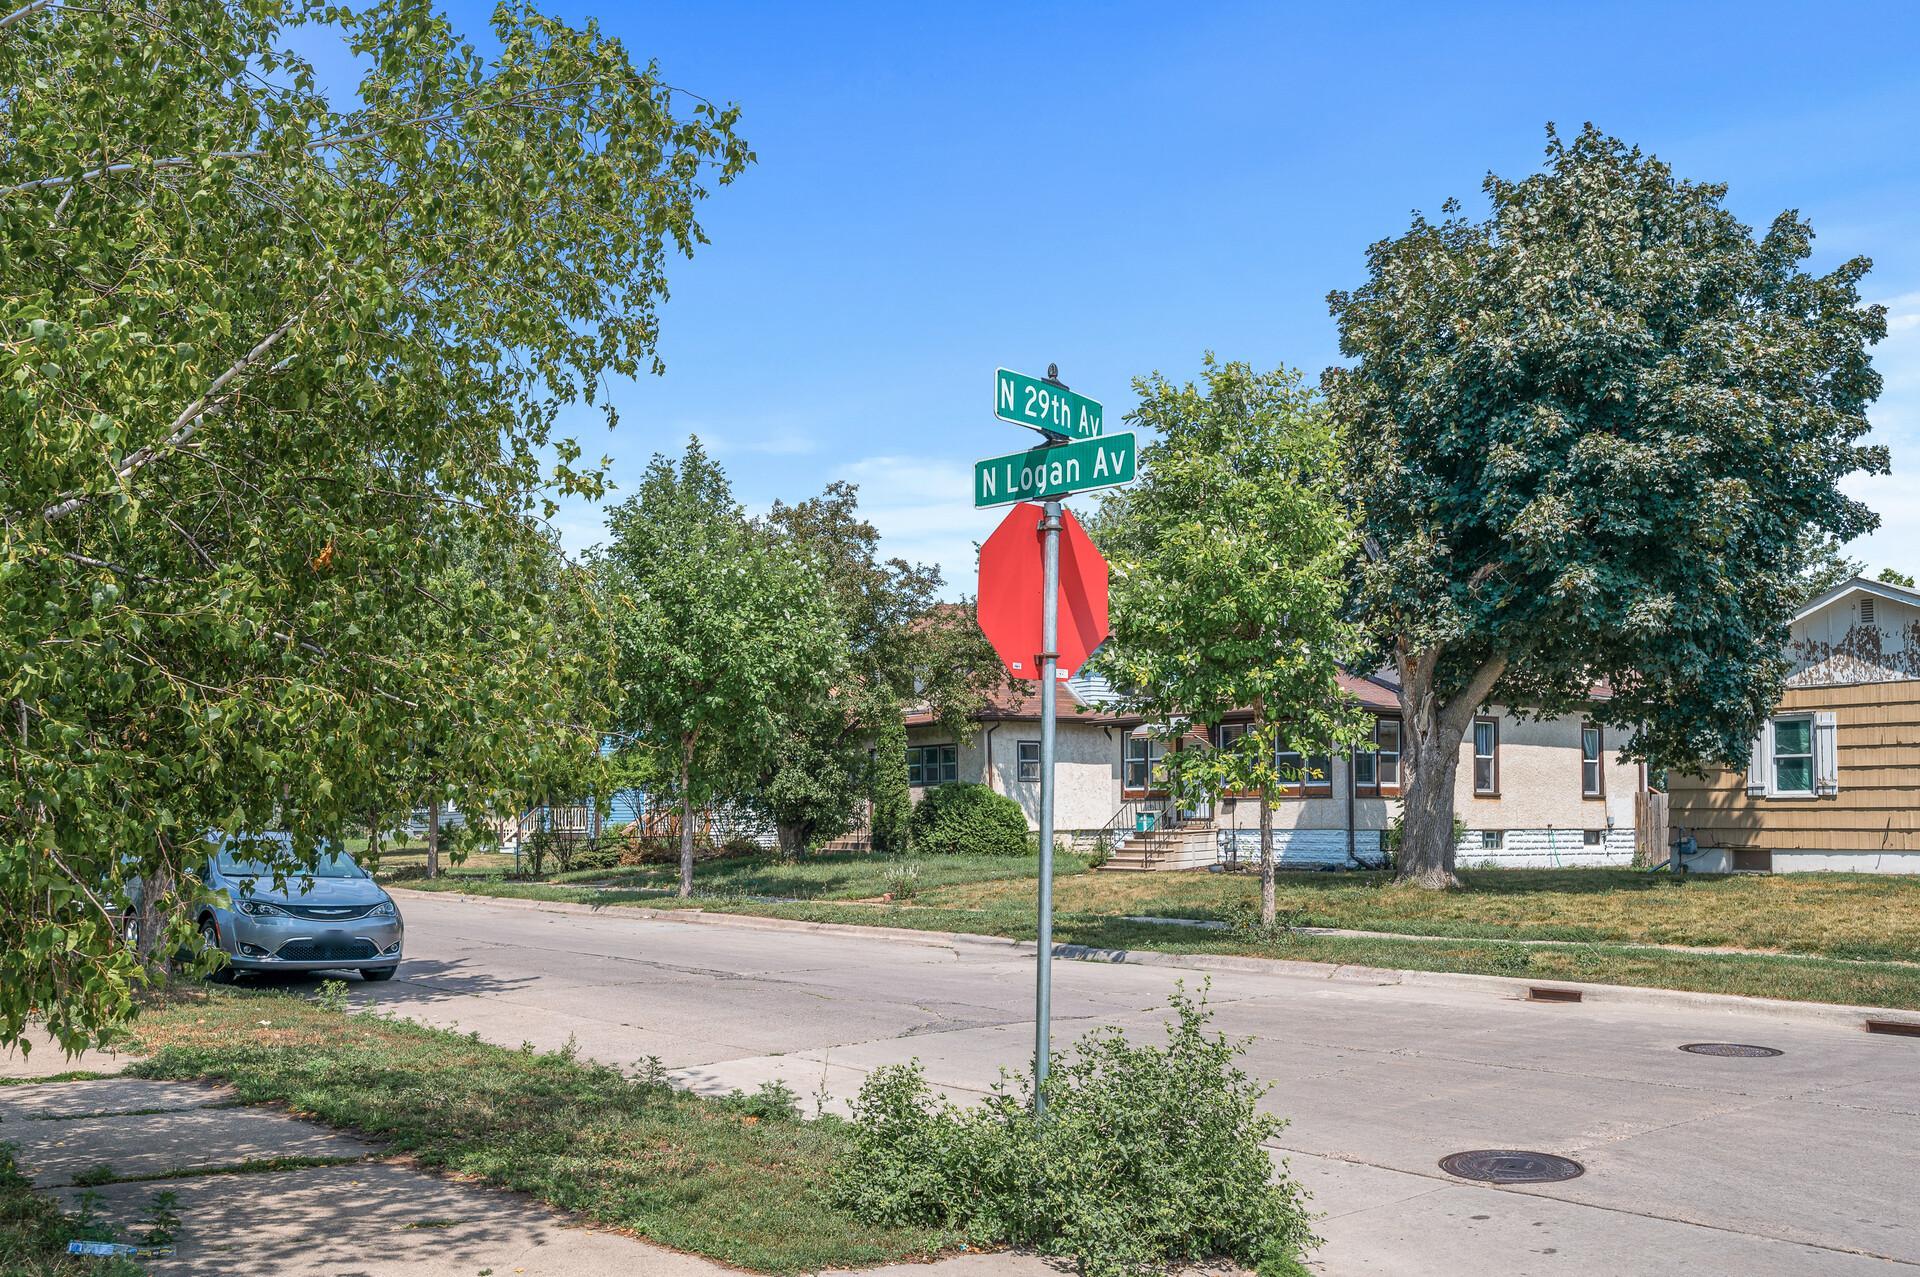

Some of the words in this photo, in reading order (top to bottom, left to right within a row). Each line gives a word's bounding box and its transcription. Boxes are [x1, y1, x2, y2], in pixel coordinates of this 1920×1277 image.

[1001, 378, 1014, 411] N
[1024, 385, 1071, 429] 29th
[1078, 404, 1100, 437] Av
[983, 467, 996, 498] N
[1007, 458, 1080, 495] Logan
[1092, 446, 1126, 479] Av
